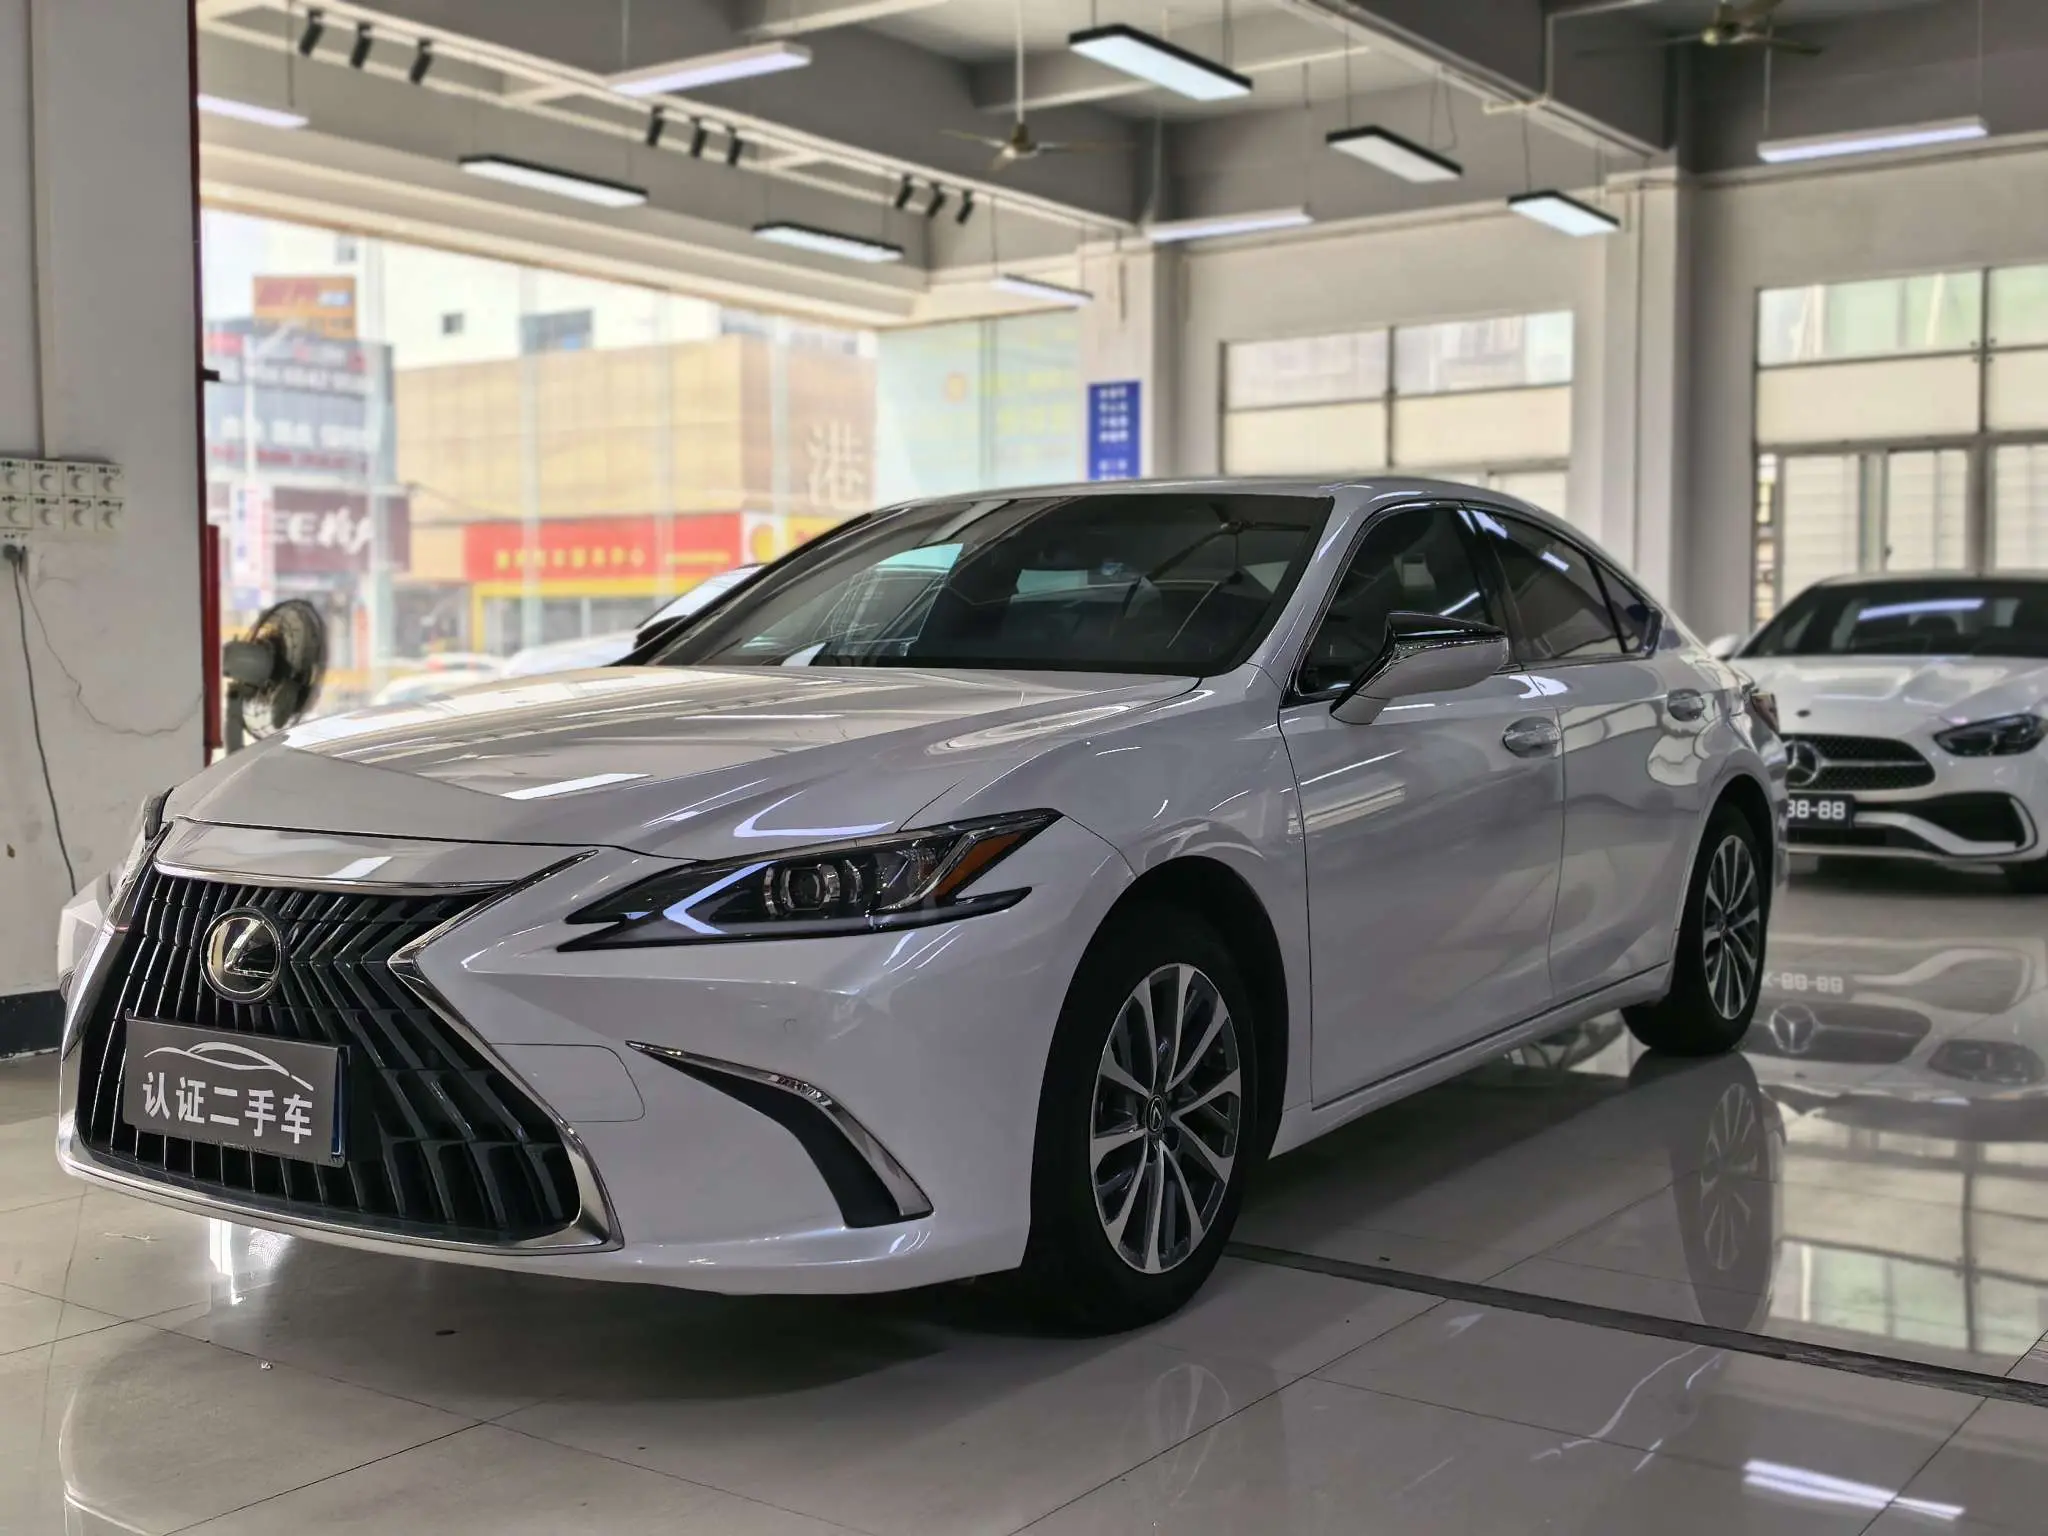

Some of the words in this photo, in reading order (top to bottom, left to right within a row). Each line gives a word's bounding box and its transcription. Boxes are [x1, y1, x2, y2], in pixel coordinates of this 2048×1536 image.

[804, 419, 866, 511] 港
[143, 1072, 313, 1144] 认证二手车
